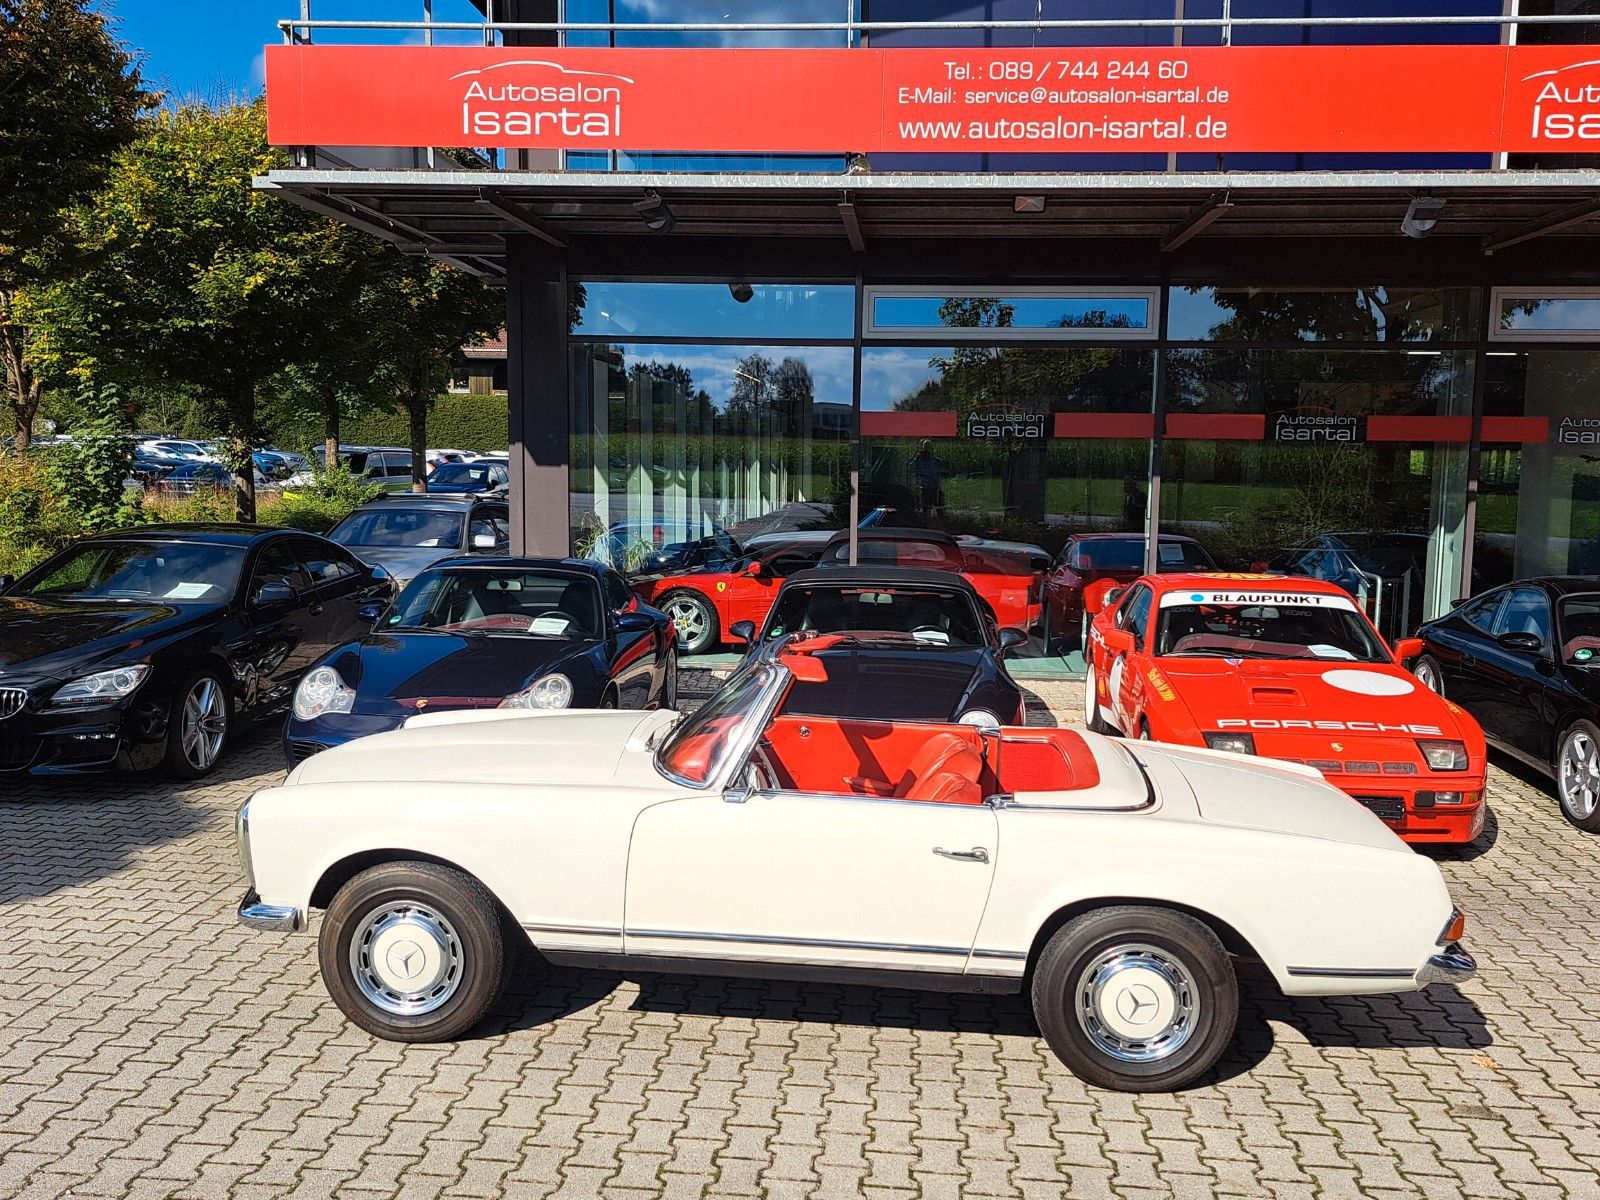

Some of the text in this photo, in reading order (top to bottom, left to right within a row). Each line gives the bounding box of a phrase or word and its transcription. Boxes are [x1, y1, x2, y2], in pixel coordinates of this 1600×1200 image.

[943, 61, 983, 81] Tel.:
[1107, 61, 1150, 80] 244
[1158, 60, 1188, 79] 60
[464, 80, 621, 102] Autosalon
[898, 86, 1229, 104] E-Mail: service@autosalon-isartal.de
[463, 102, 621, 137] Isartal
[898, 115, 1228, 139] www.autosalon-isartal.de
[968, 411, 1045, 422] Autosalon
[1276, 414, 1357, 425] Autosalon
[966, 421, 1045, 438] Isartal
[1275, 425, 1357, 441] Isartal
[1212, 593, 1324, 605] BLAUPUNKT
[1216, 718, 1444, 736] PORSCHE
